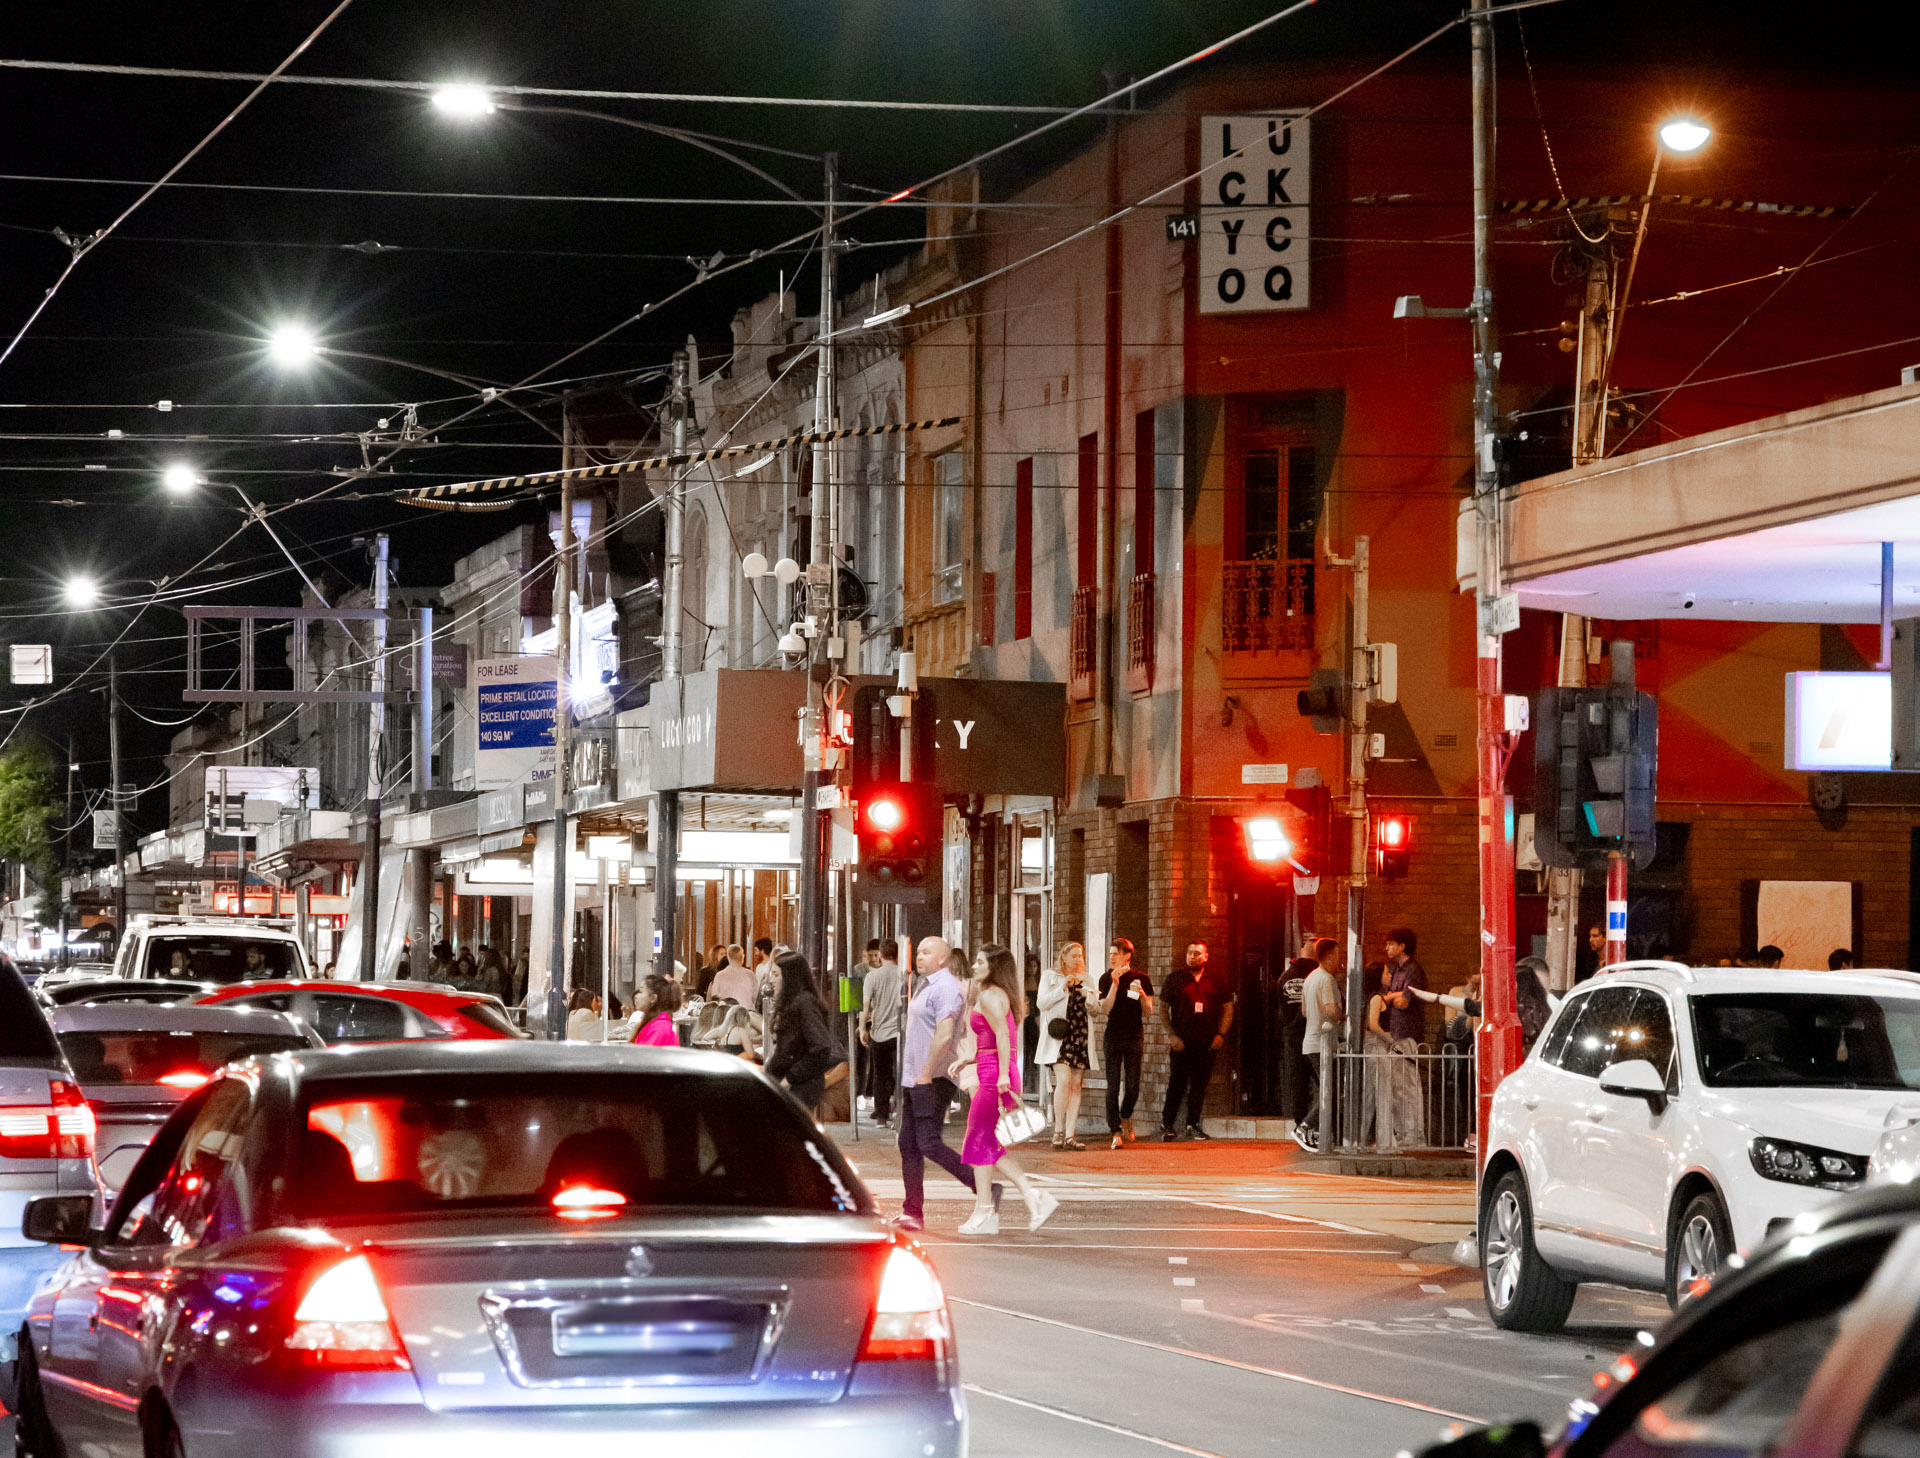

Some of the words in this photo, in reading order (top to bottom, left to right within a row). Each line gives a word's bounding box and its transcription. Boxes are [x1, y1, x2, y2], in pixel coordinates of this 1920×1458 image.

[1169, 220, 1196, 237] 141
[477, 666, 493, 677] FOR
[494, 664, 519, 677] LEASE
[480, 692, 503, 704] PRIME
[503, 690, 527, 703] RETAIL
[527, 688, 557, 701] LOCATIO
[480, 710, 520, 723] EXCELLENT
[520, 708, 556, 721] CONDITIO
[480, 731, 492, 742] 140
[492, 730, 503, 741] SQ
[661, 717, 686, 749] LUCKY
[95, 930, 112, 939] JR
